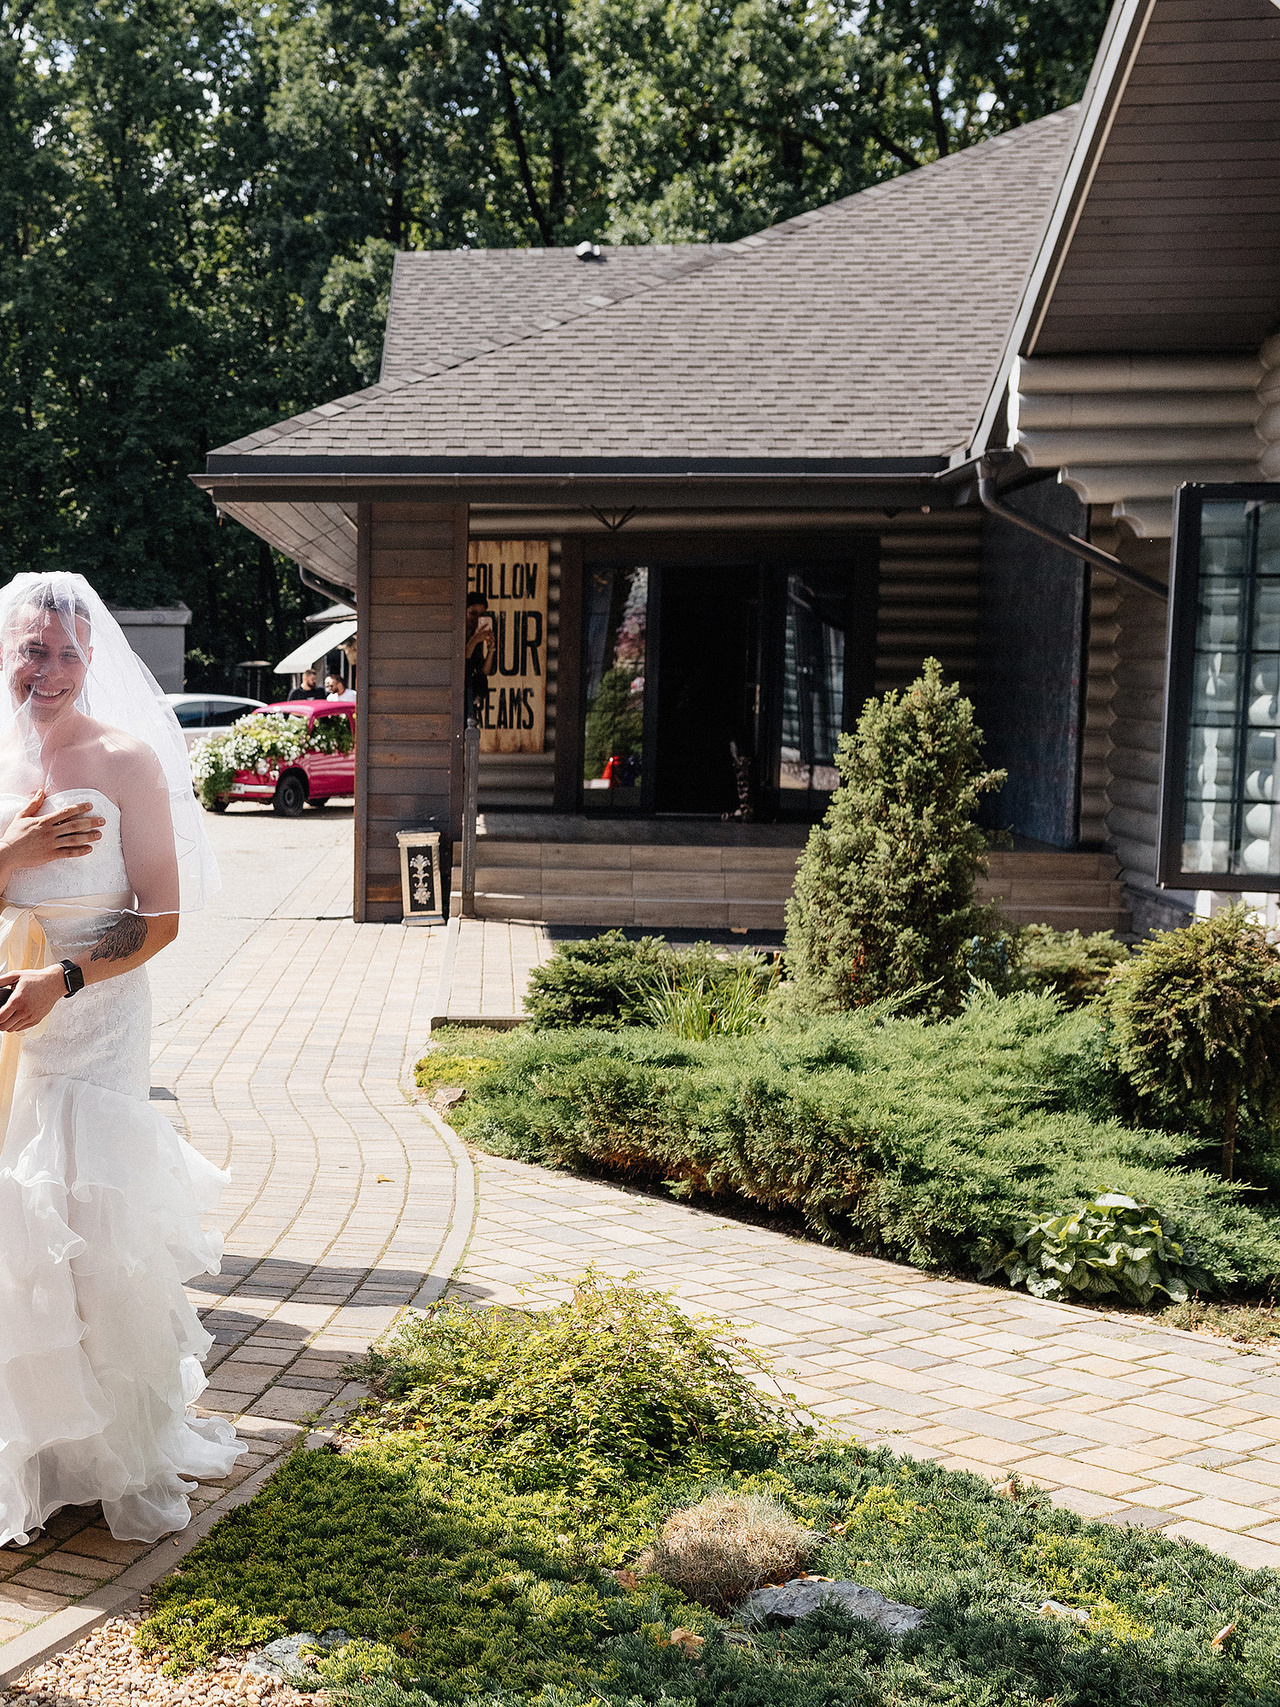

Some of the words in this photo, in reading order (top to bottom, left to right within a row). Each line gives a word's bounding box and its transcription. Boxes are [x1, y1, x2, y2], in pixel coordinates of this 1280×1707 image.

[467, 563, 538, 599] FOLLOW
[480, 610, 543, 677] OUR
[475, 687, 535, 730] REAMS
